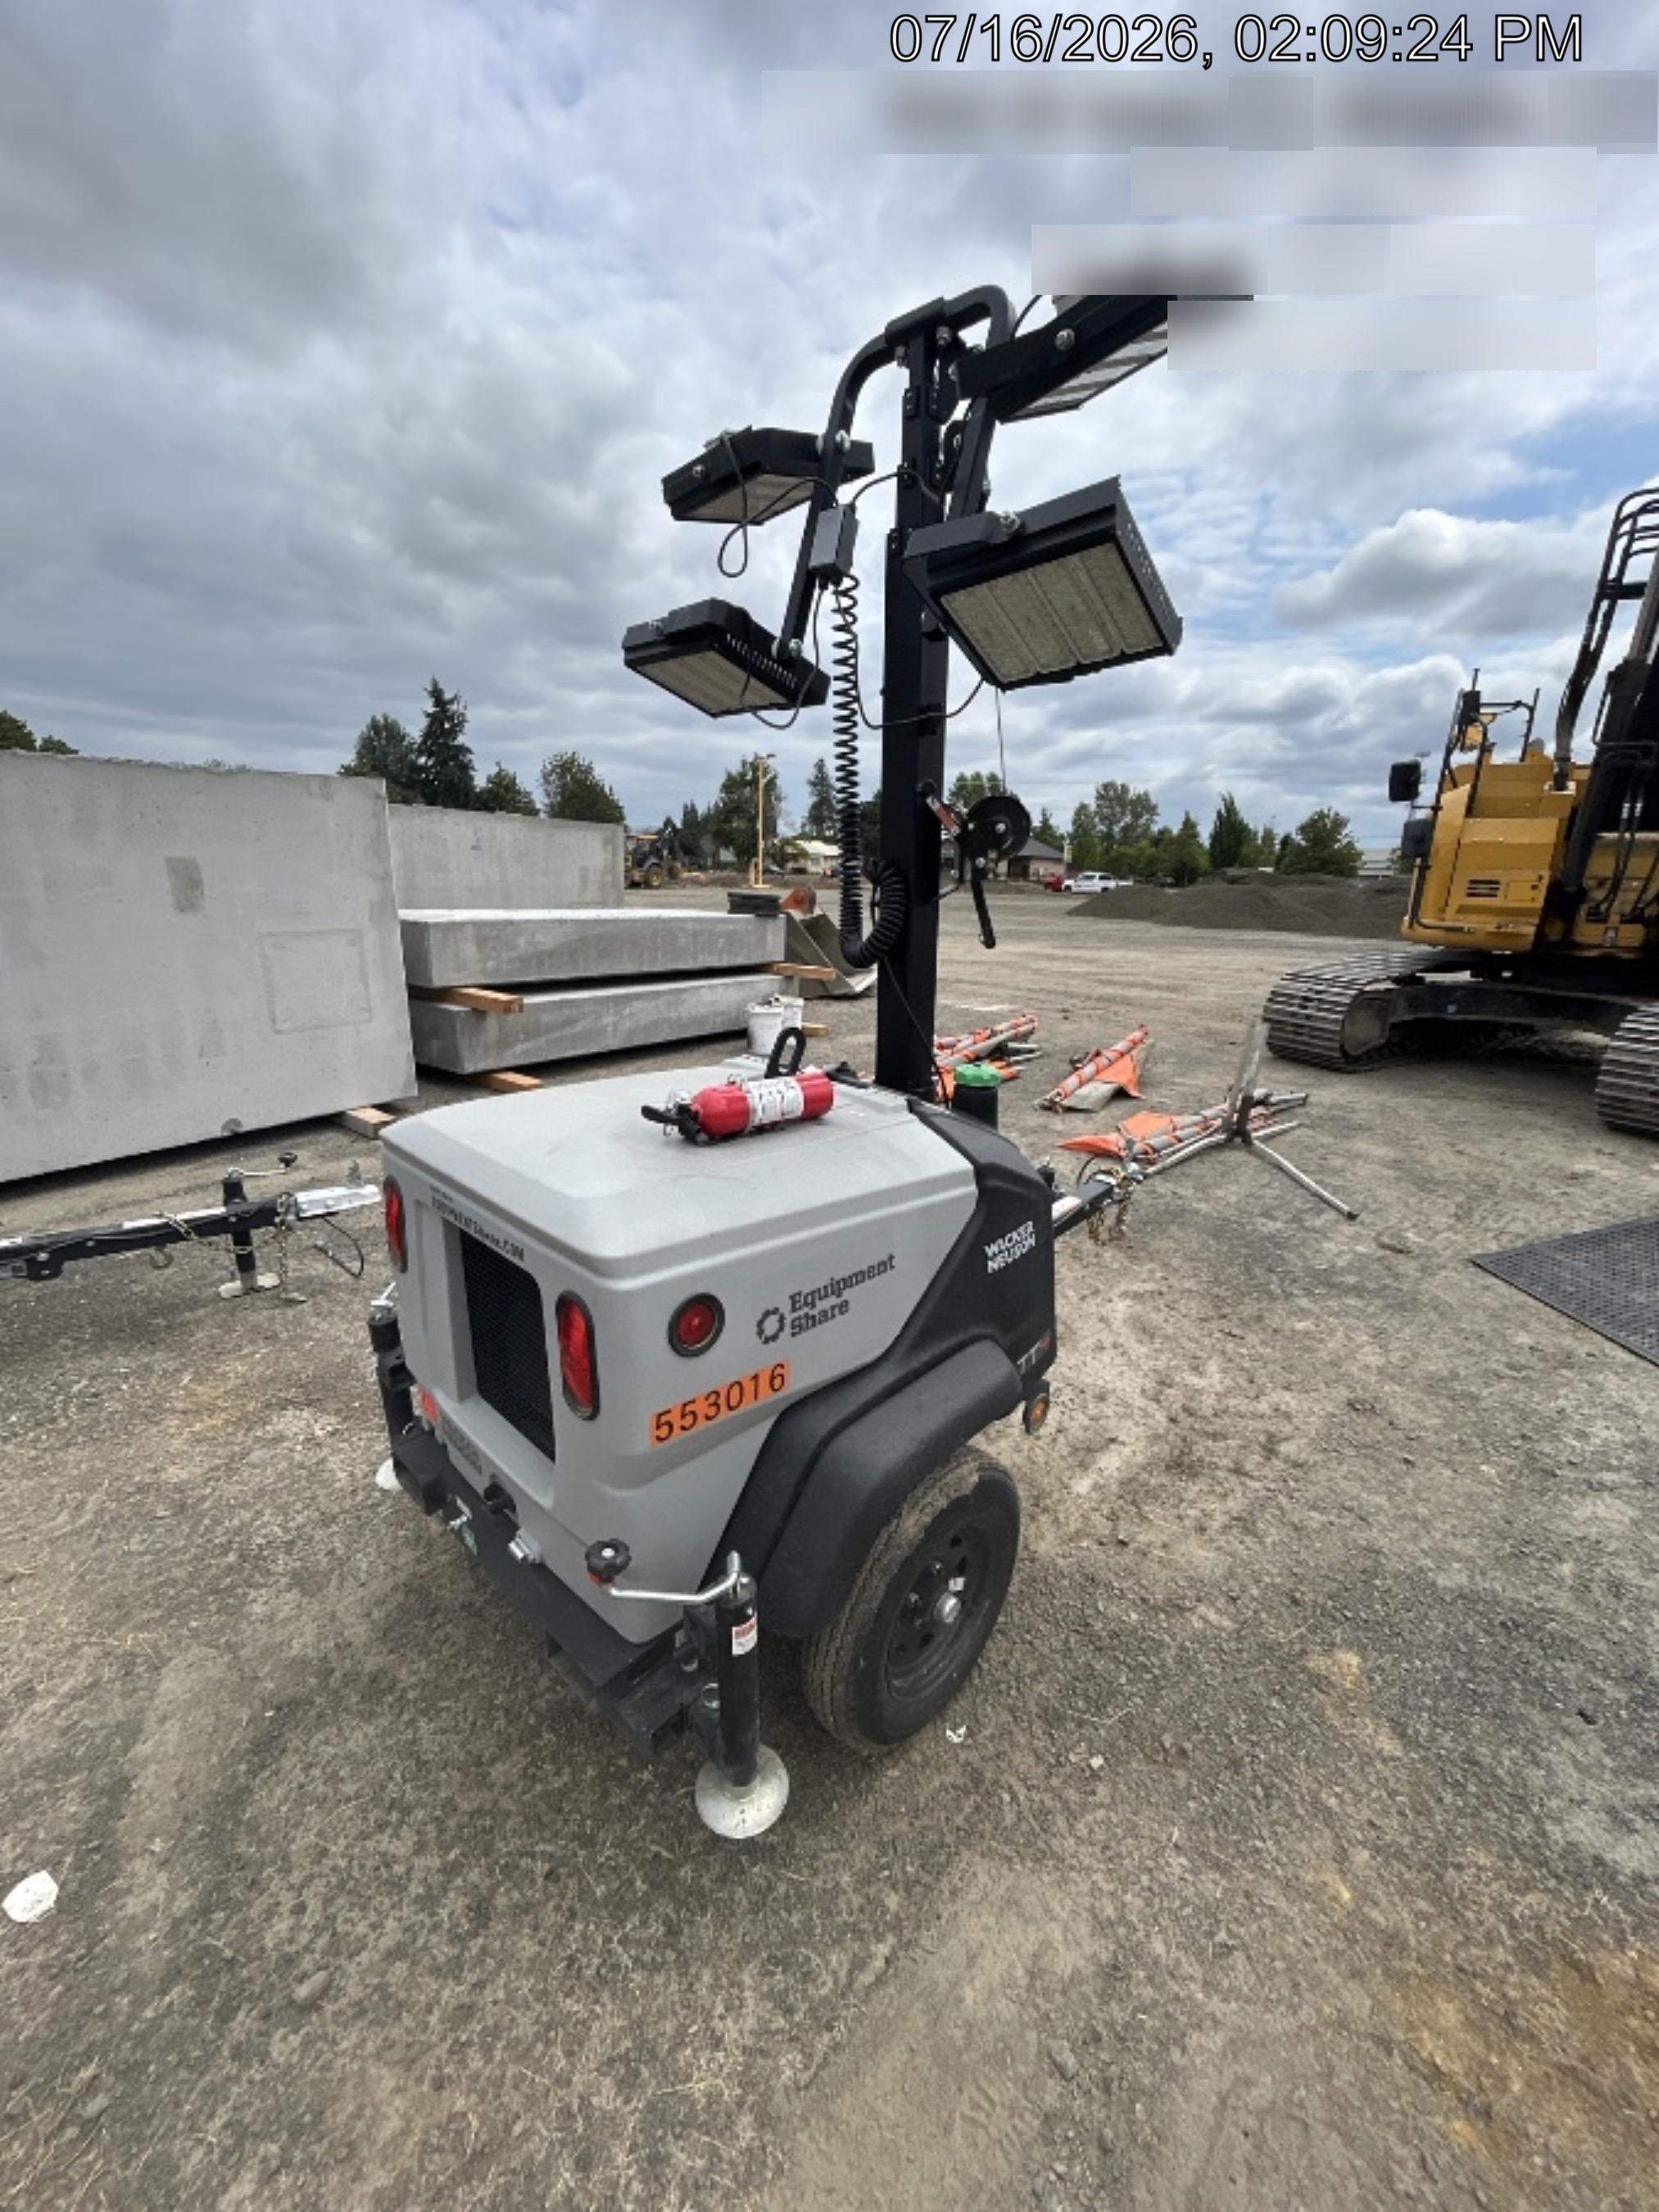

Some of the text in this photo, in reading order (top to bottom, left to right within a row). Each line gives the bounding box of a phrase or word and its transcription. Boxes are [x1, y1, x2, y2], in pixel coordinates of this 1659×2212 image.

[984, 1221, 1035, 1258] WACKER
[987, 1233, 1036, 1274] NEUSON
[788, 1253, 895, 1314] Equipment
[791, 1299, 850, 1338] Share
[655, 1362, 786, 1443] 553016
